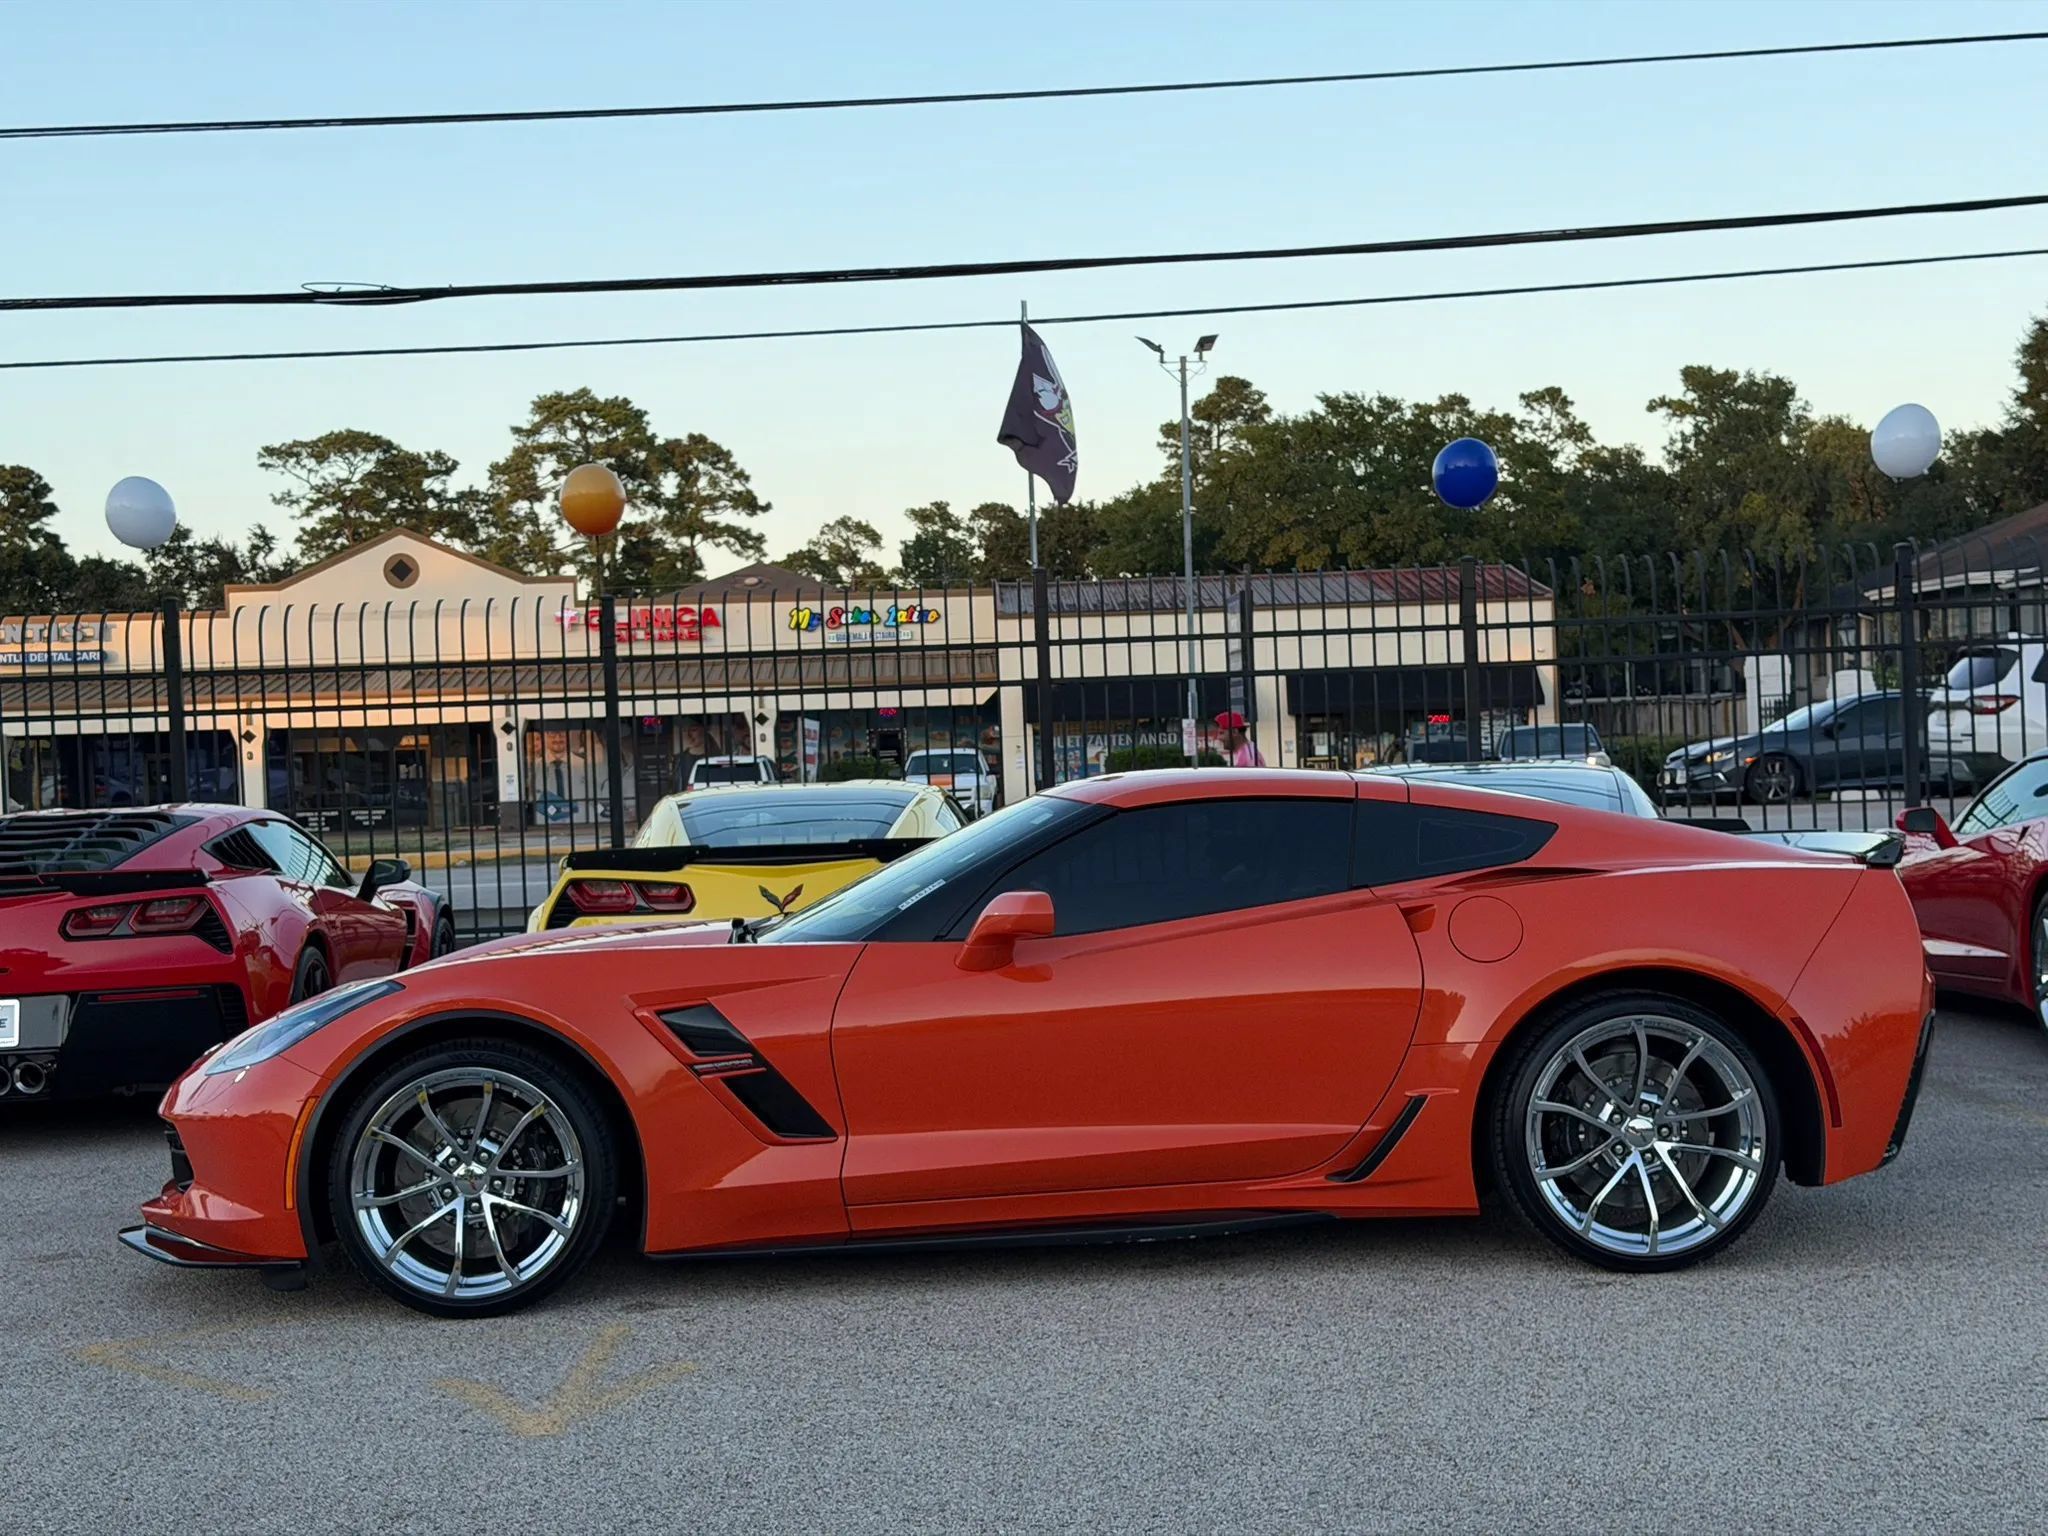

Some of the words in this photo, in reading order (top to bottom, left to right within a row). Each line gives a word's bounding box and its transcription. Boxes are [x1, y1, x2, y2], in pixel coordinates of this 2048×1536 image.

[789, 607, 821, 632] My
[826, 606, 881, 630] Sabor
[884, 604, 941, 627] Latino
[0, 653, 28, 664] NTL
[75, 650, 102, 661] CAR
[1053, 731, 1178, 749] UETZALTENANGO
